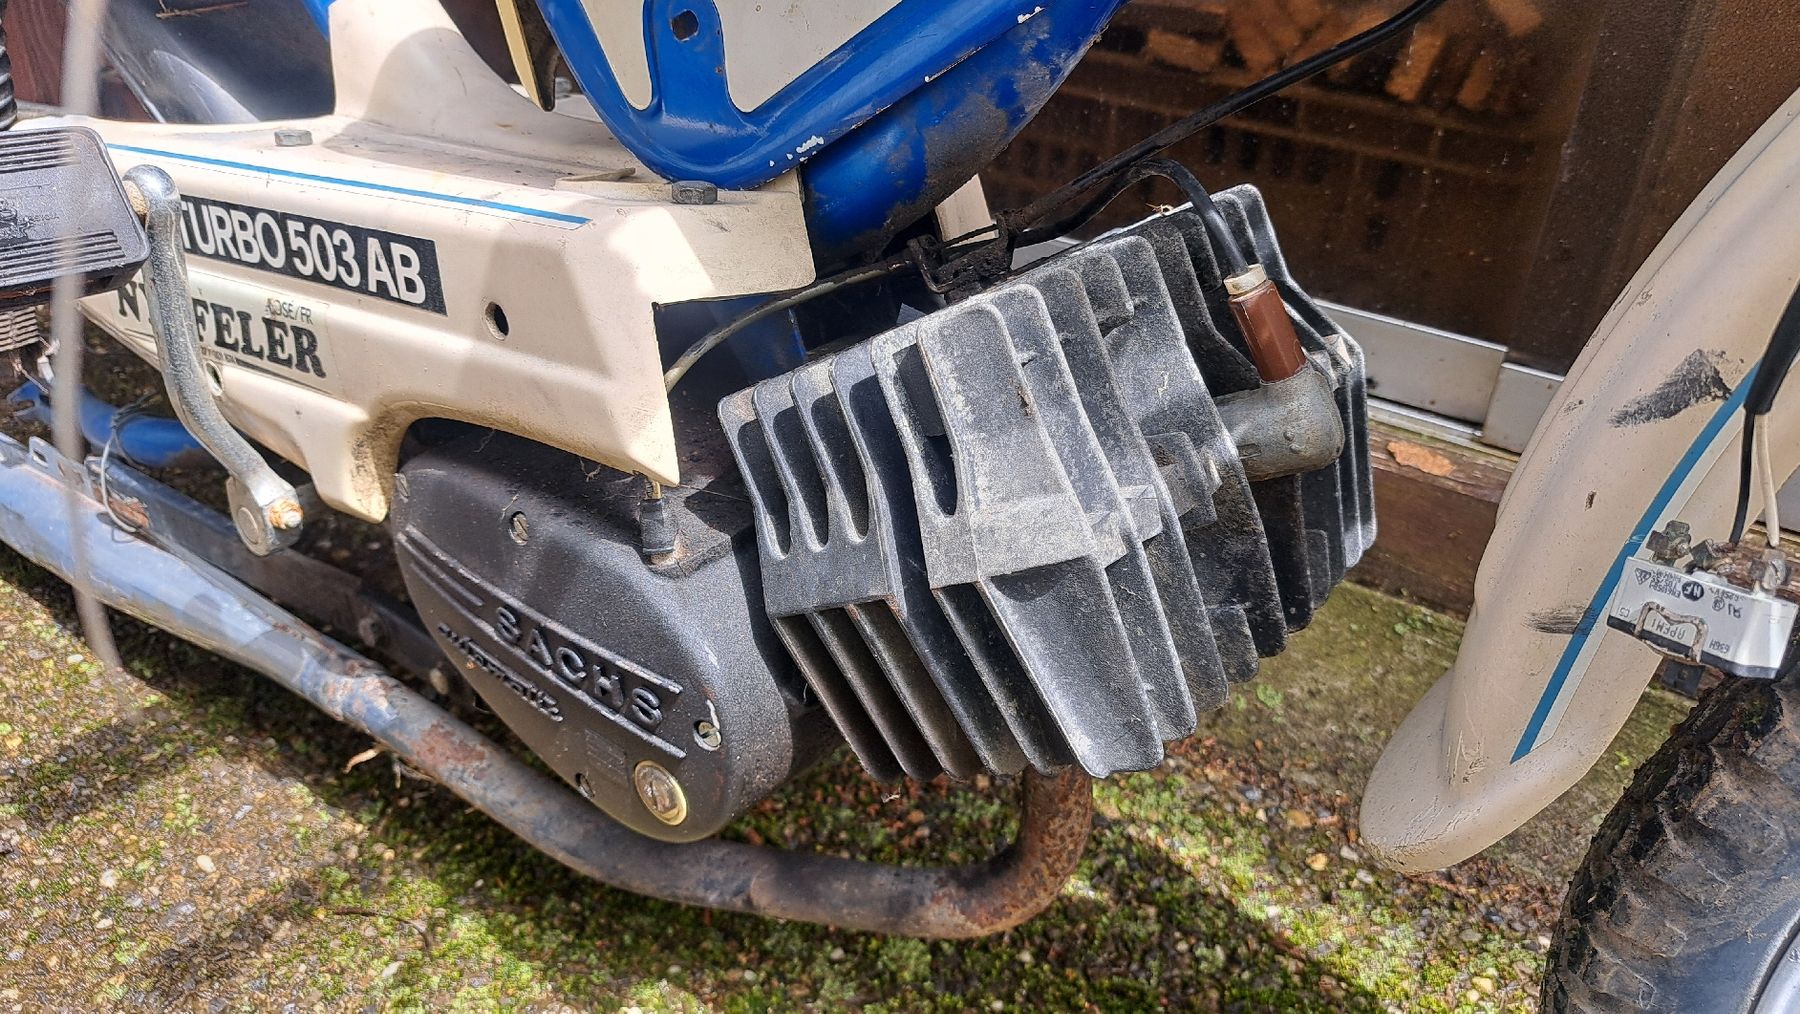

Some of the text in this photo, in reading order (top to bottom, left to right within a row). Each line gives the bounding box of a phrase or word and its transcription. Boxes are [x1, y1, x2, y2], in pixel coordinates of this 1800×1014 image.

[181, 200, 426, 304] TURBO 503 AB
[495, 606, 664, 726] SACHS
